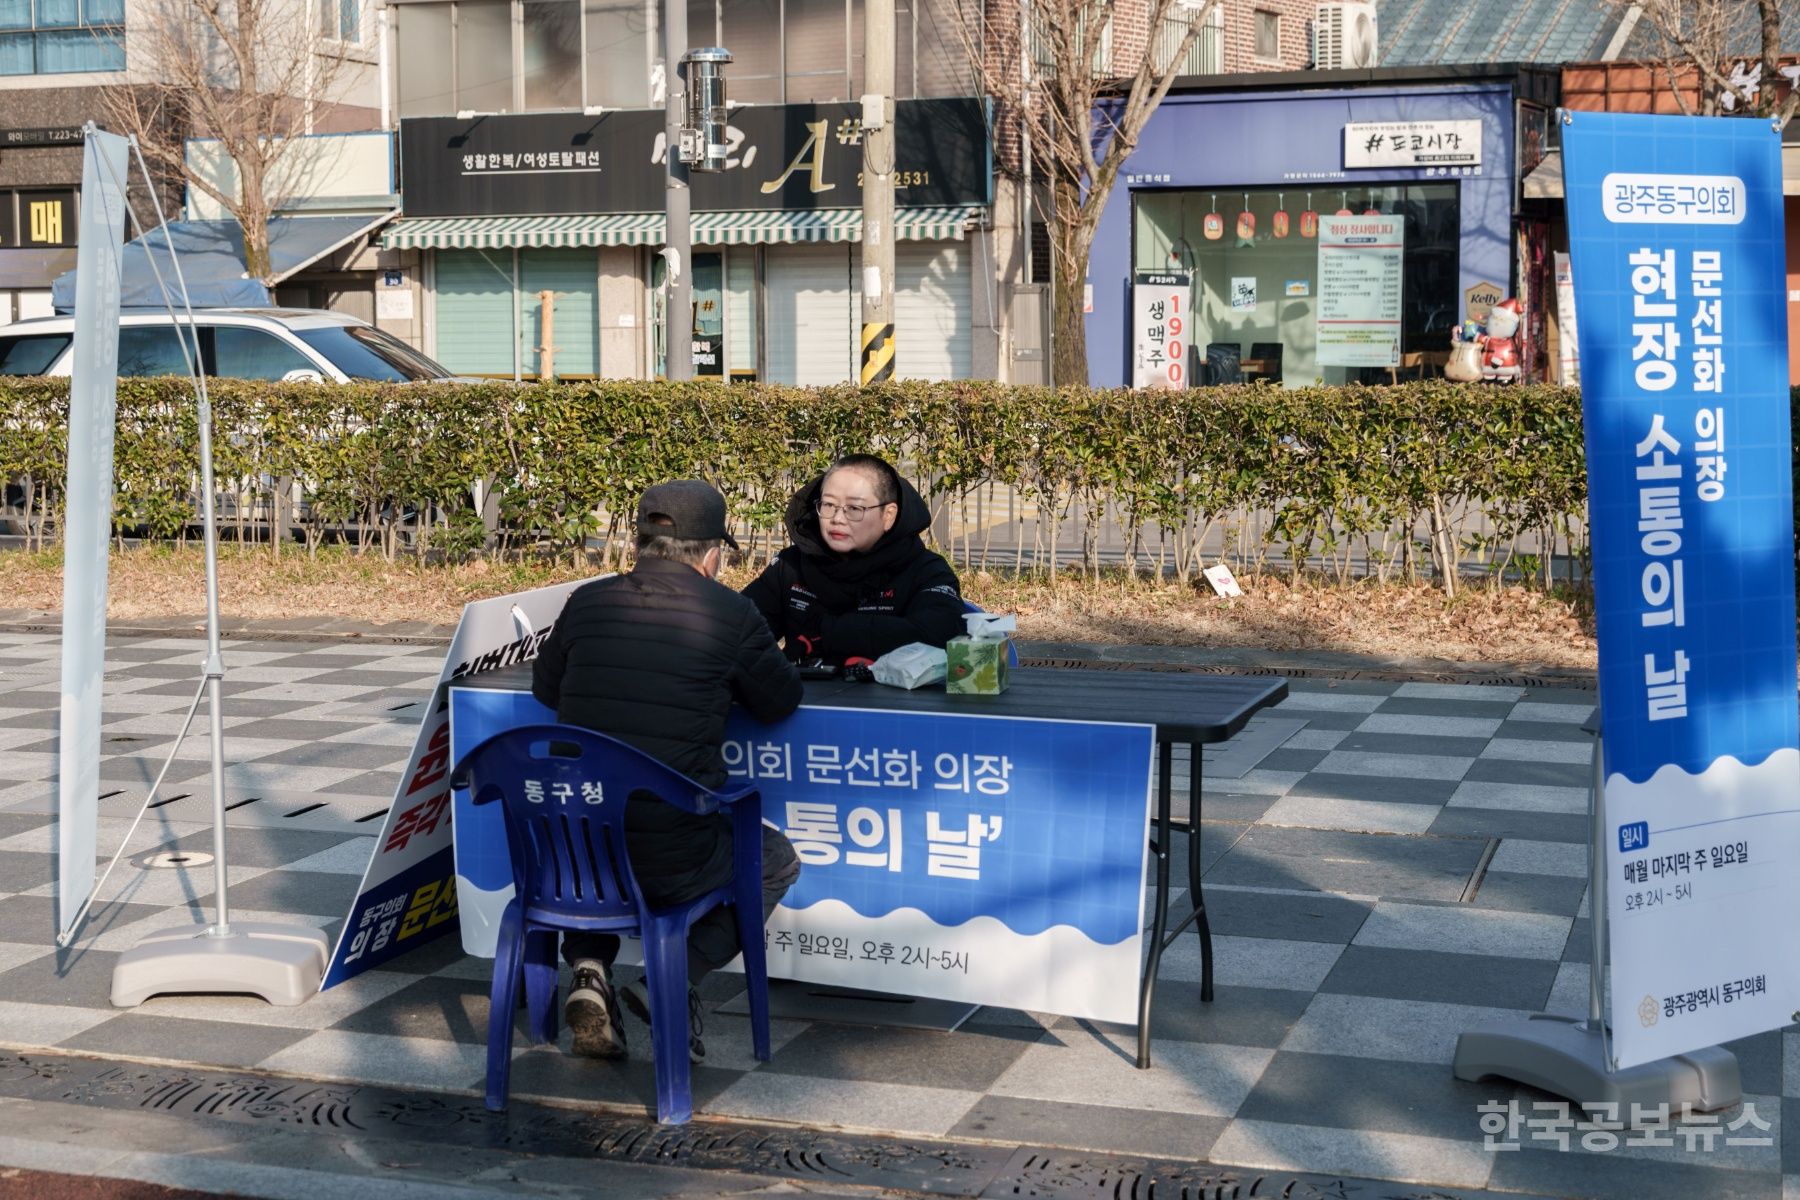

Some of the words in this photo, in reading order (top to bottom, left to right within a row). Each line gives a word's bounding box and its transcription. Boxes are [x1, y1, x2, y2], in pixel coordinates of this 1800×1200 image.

[48, 130, 85, 140] T.223-47
[1614, 184, 1735, 216] 광주동구의회
[1470, 294, 1500, 305] Kelly
[1628, 247, 1681, 392] 현장
[1690, 250, 1726, 393] 문선화
[1147, 300, 1165, 368] 생맥주
[1694, 407, 1728, 502] 의장
[1635, 413, 1685, 628] 소통의
[1644, 649, 1691, 722] 날
[721, 740, 792, 782] 의회
[806, 744, 922, 789] 문선화
[934, 753, 1013, 795] 의장
[762, 801, 902, 873] 통의
[1621, 825, 1643, 848] 일시
[1624, 859, 1648, 884] 매월
[1652, 851, 1690, 878] 마지막
[1694, 849, 1707, 871] 주
[1711, 841, 1748, 868] 일요일
[359, 893, 408, 928] 동구의회
[396, 874, 459, 942] 문선
[1625, 892, 1643, 911] 오후
[1647, 888, 1663, 905] 2시
[1675, 882, 1692, 900] 5시
[775, 930, 793, 950] 주
[798, 933, 853, 961] 일요일,
[860, 941, 895, 964] 오후
[901, 946, 969, 974] 2시~5시
[1663, 985, 1720, 1018] 광주광역시
[1722, 974, 1767, 1004] 동구의회
